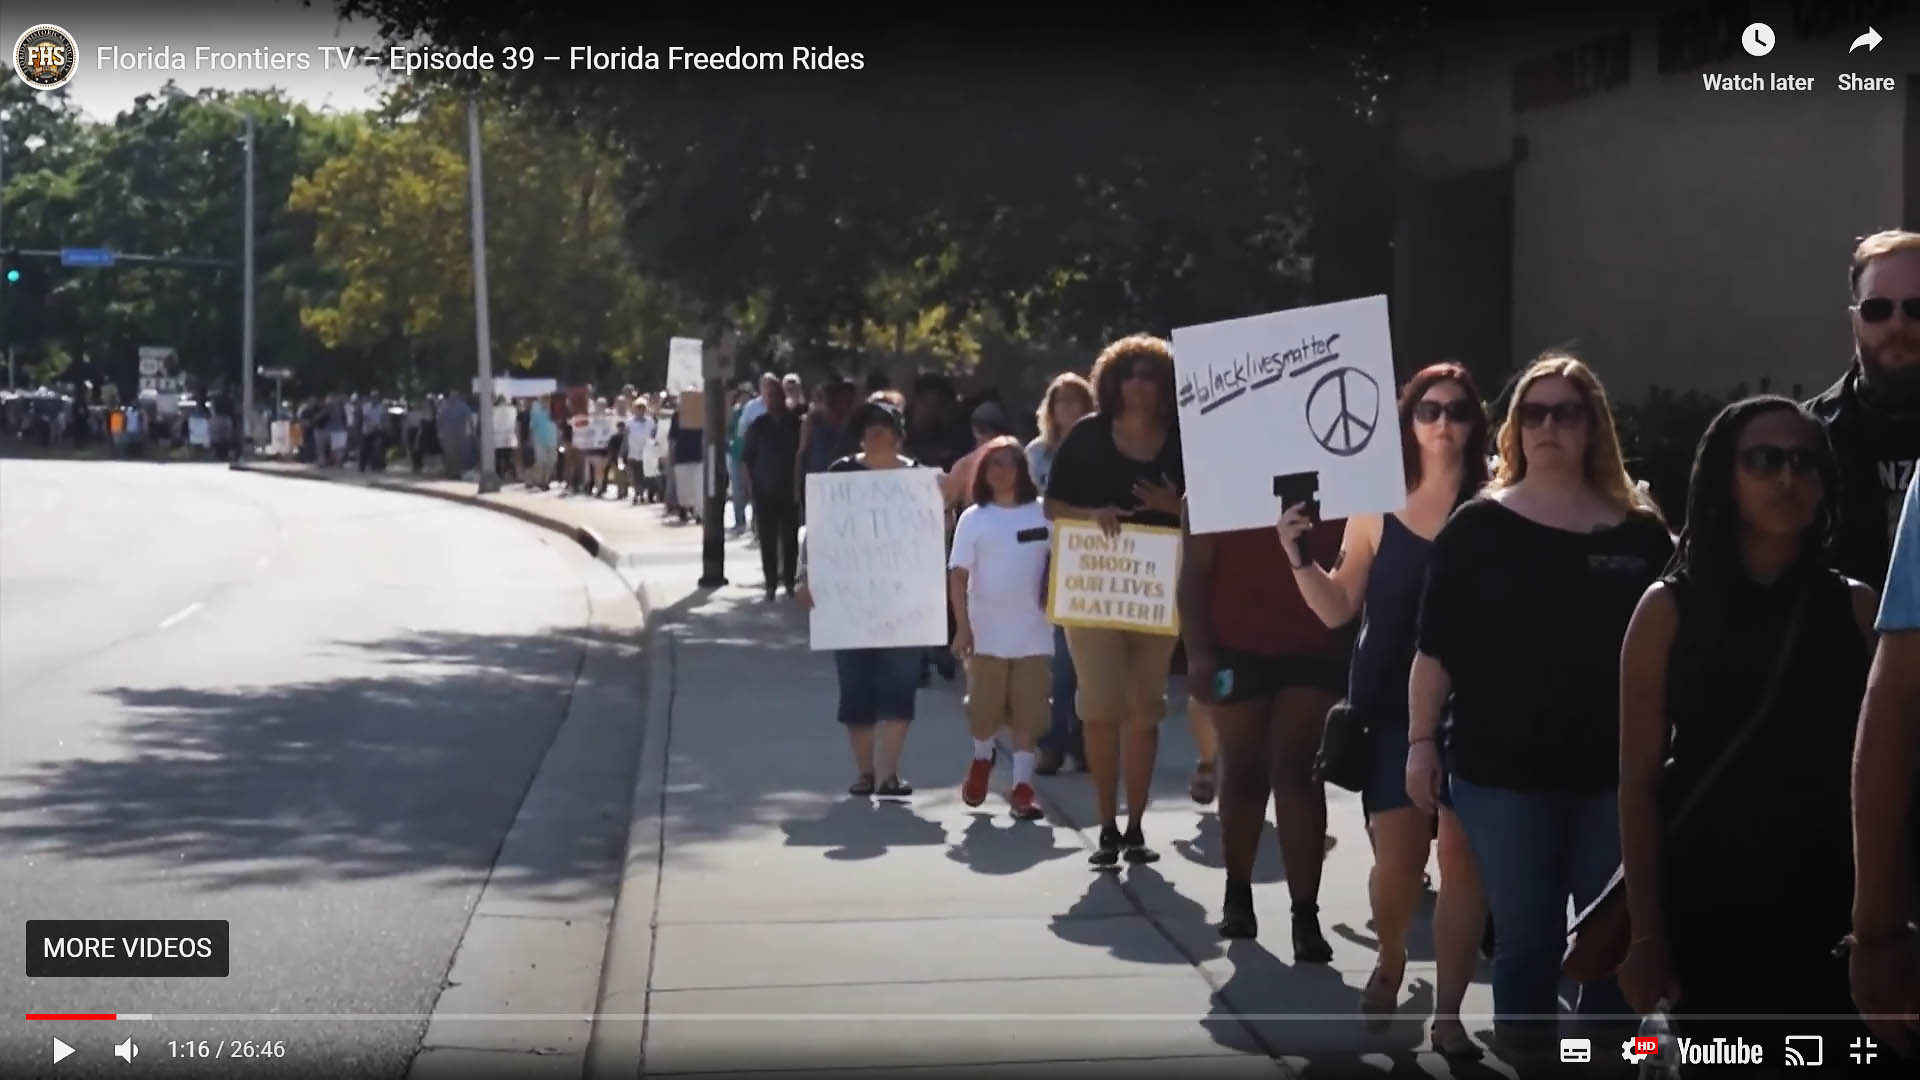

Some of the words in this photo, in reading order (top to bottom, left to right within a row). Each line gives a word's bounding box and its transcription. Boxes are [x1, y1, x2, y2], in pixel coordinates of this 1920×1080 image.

[1179, 334, 1341, 408] #blacklivesmatter
[1065, 575, 1104, 593] OUR
[1110, 577, 1165, 599] LIVES
